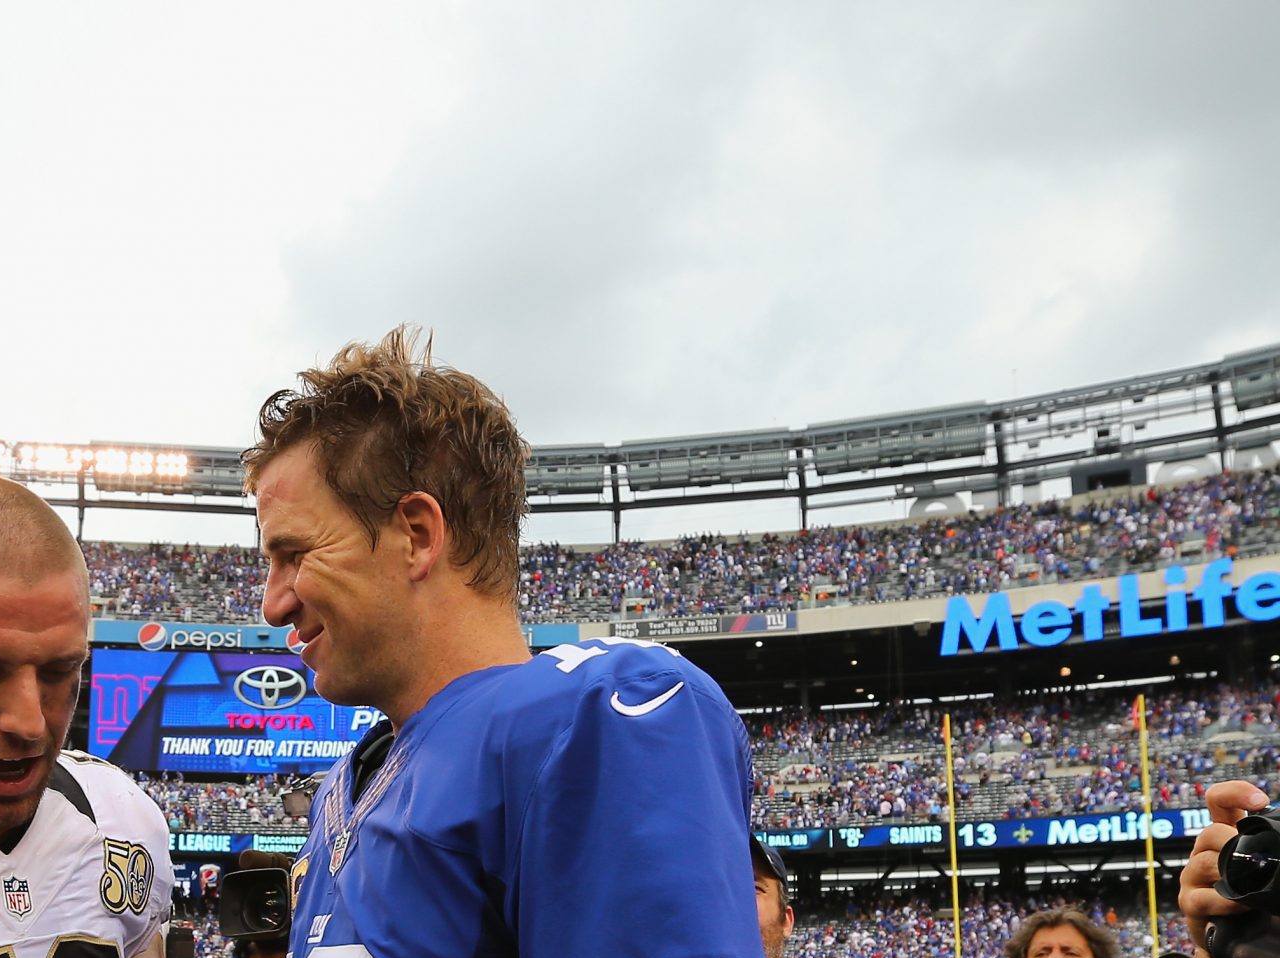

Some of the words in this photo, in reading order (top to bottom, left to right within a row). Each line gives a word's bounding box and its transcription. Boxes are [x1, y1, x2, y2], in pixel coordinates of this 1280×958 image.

[940, 557, 1280, 656] MetLife
[615, 622, 637, 631] Need
[615, 629, 640, 639] Help?
[171, 629, 242, 650] pepsi
[225, 713, 314, 730] TOYOTA
[161, 736, 212, 755] THANK
[212, 738, 245, 756] YOU
[246, 739, 275, 757] FOR
[889, 825, 942, 844] SAINTS
[958, 823, 996, 847] 13
[1047, 812, 1174, 846] MetLife
[178, 833, 231, 852] LEAGUE
[768, 835, 791, 847] BALL
[792, 834, 808, 846] ON
[100, 838, 154, 915] 50
[7, 893, 31, 911] NFL
